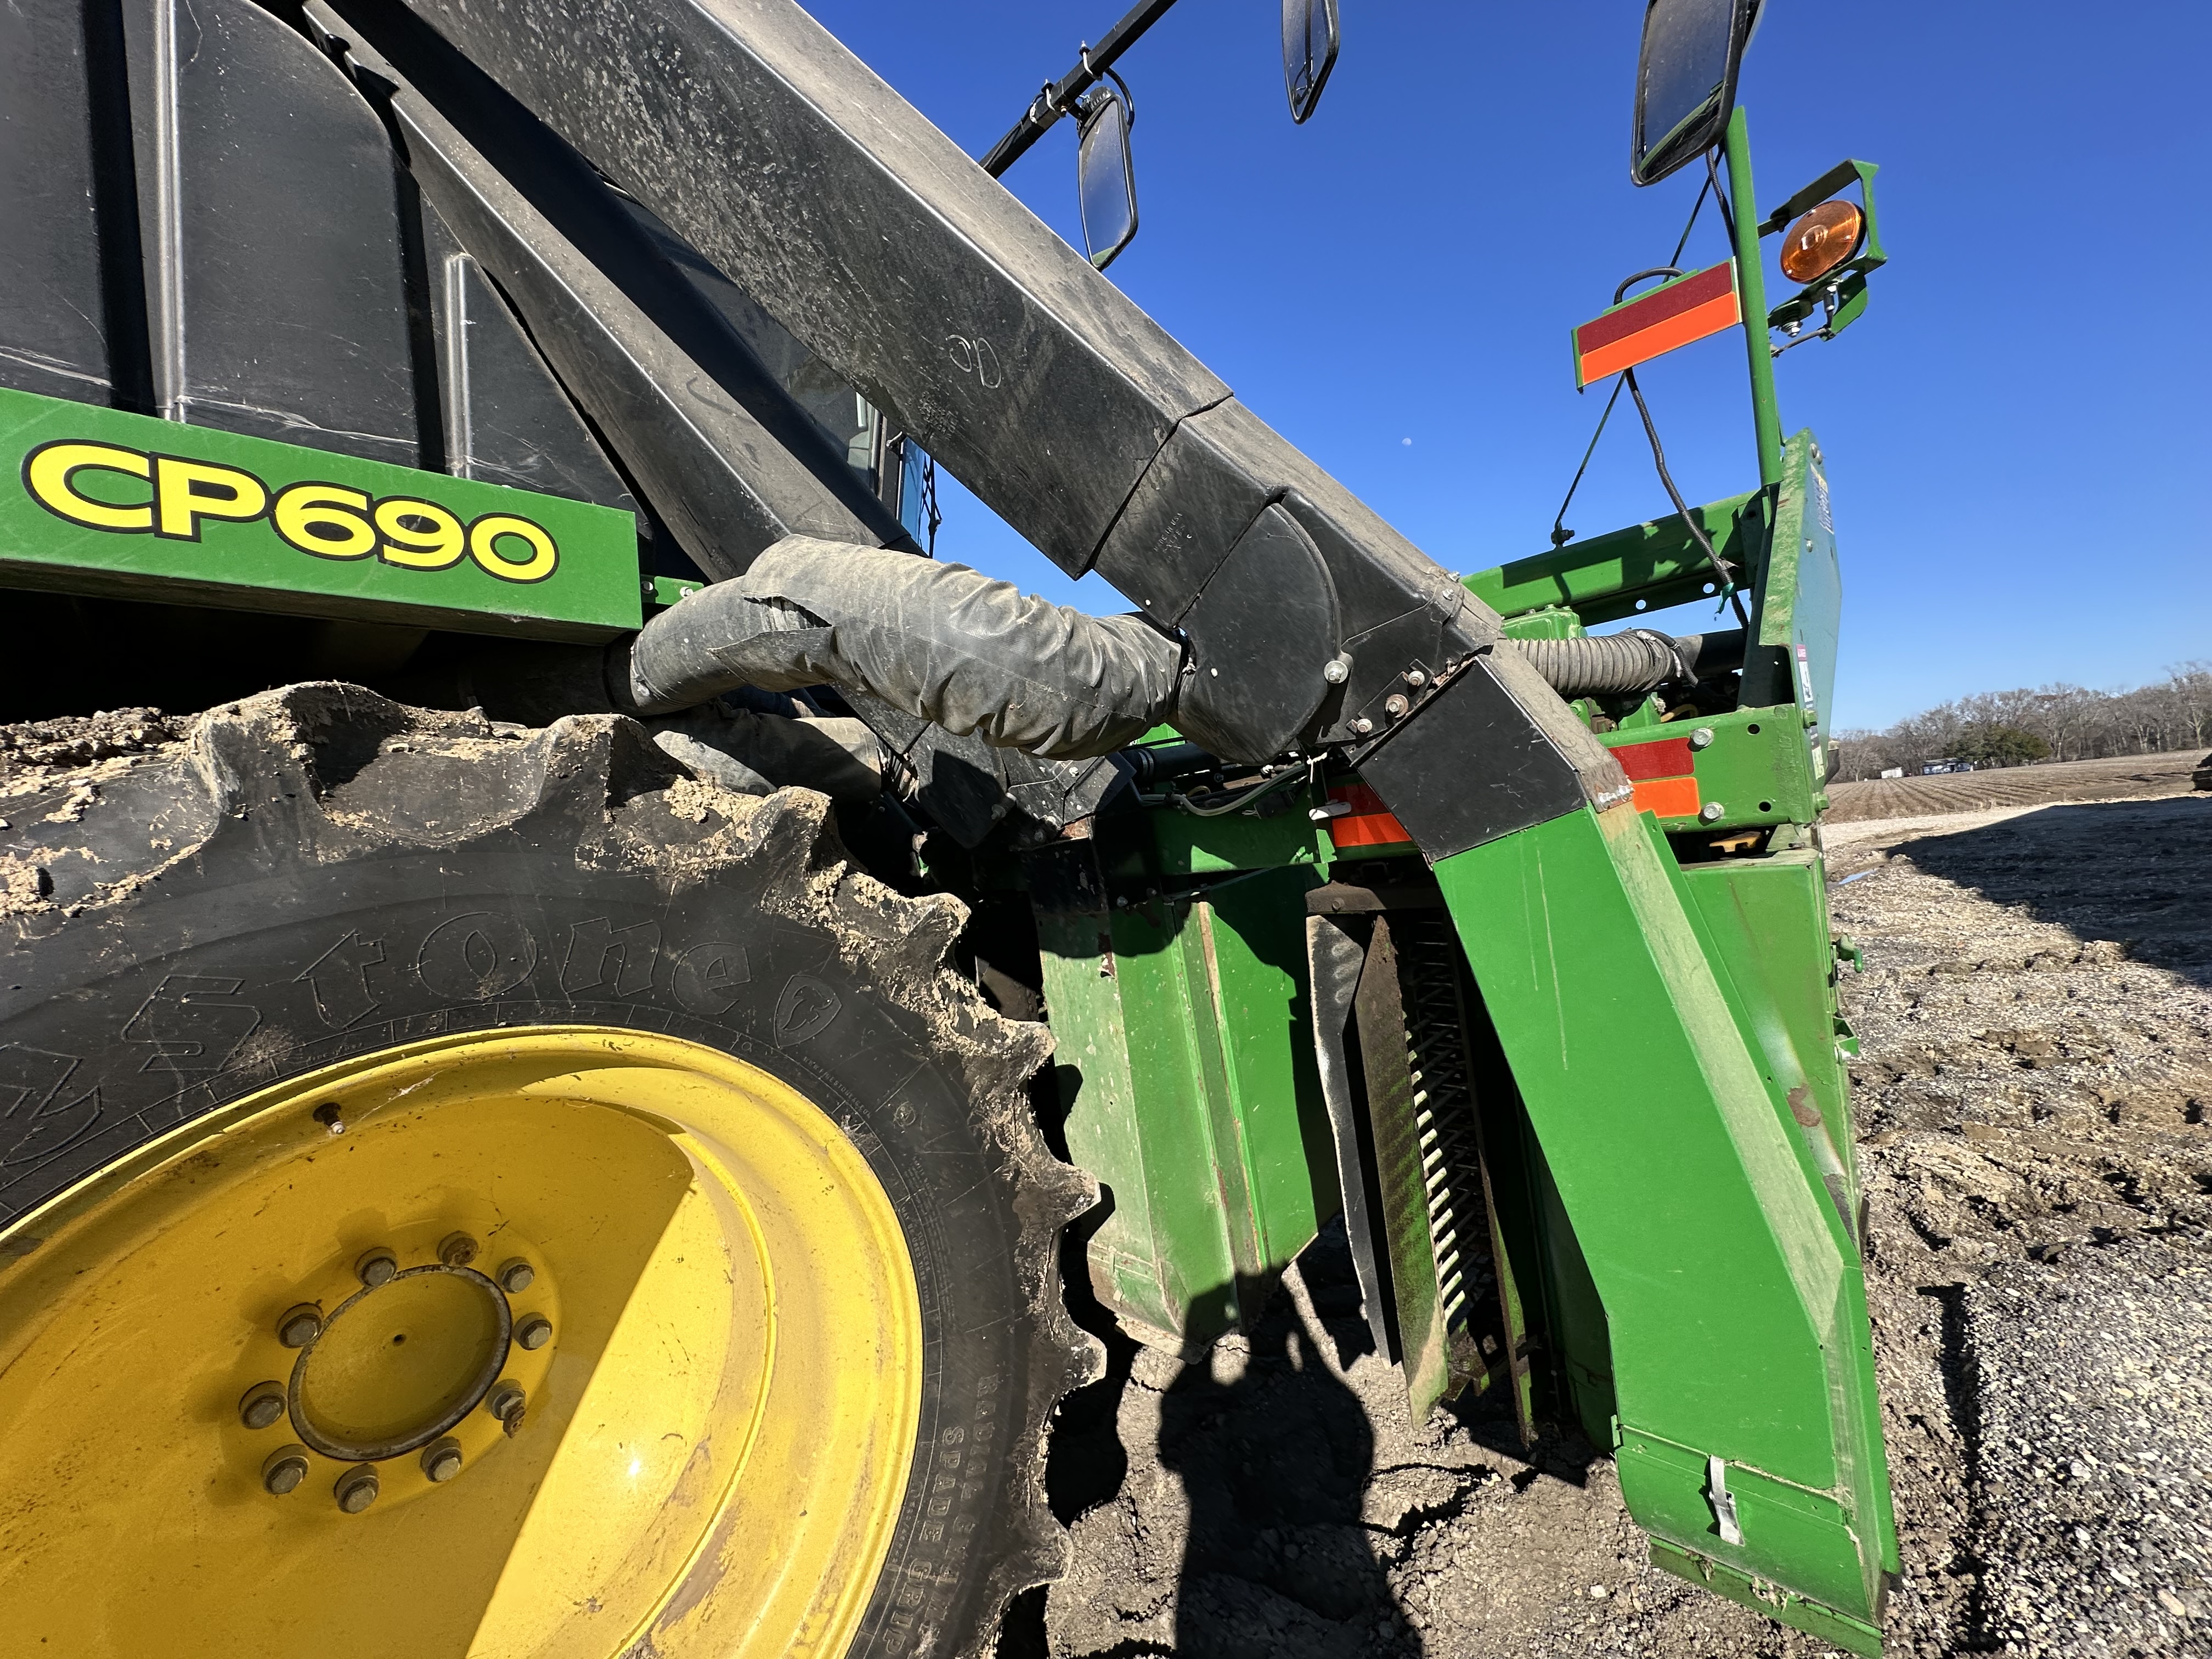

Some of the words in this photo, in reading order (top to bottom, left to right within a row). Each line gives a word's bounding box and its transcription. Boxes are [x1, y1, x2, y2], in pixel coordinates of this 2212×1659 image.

[22, 439, 560, 584] CP690
[1164, 525, 1173, 534] IN
[919, 1426, 966, 1543] SPADE
[960, 1374, 996, 1500] RADIAL
[882, 1558, 933, 1655] GRIP
